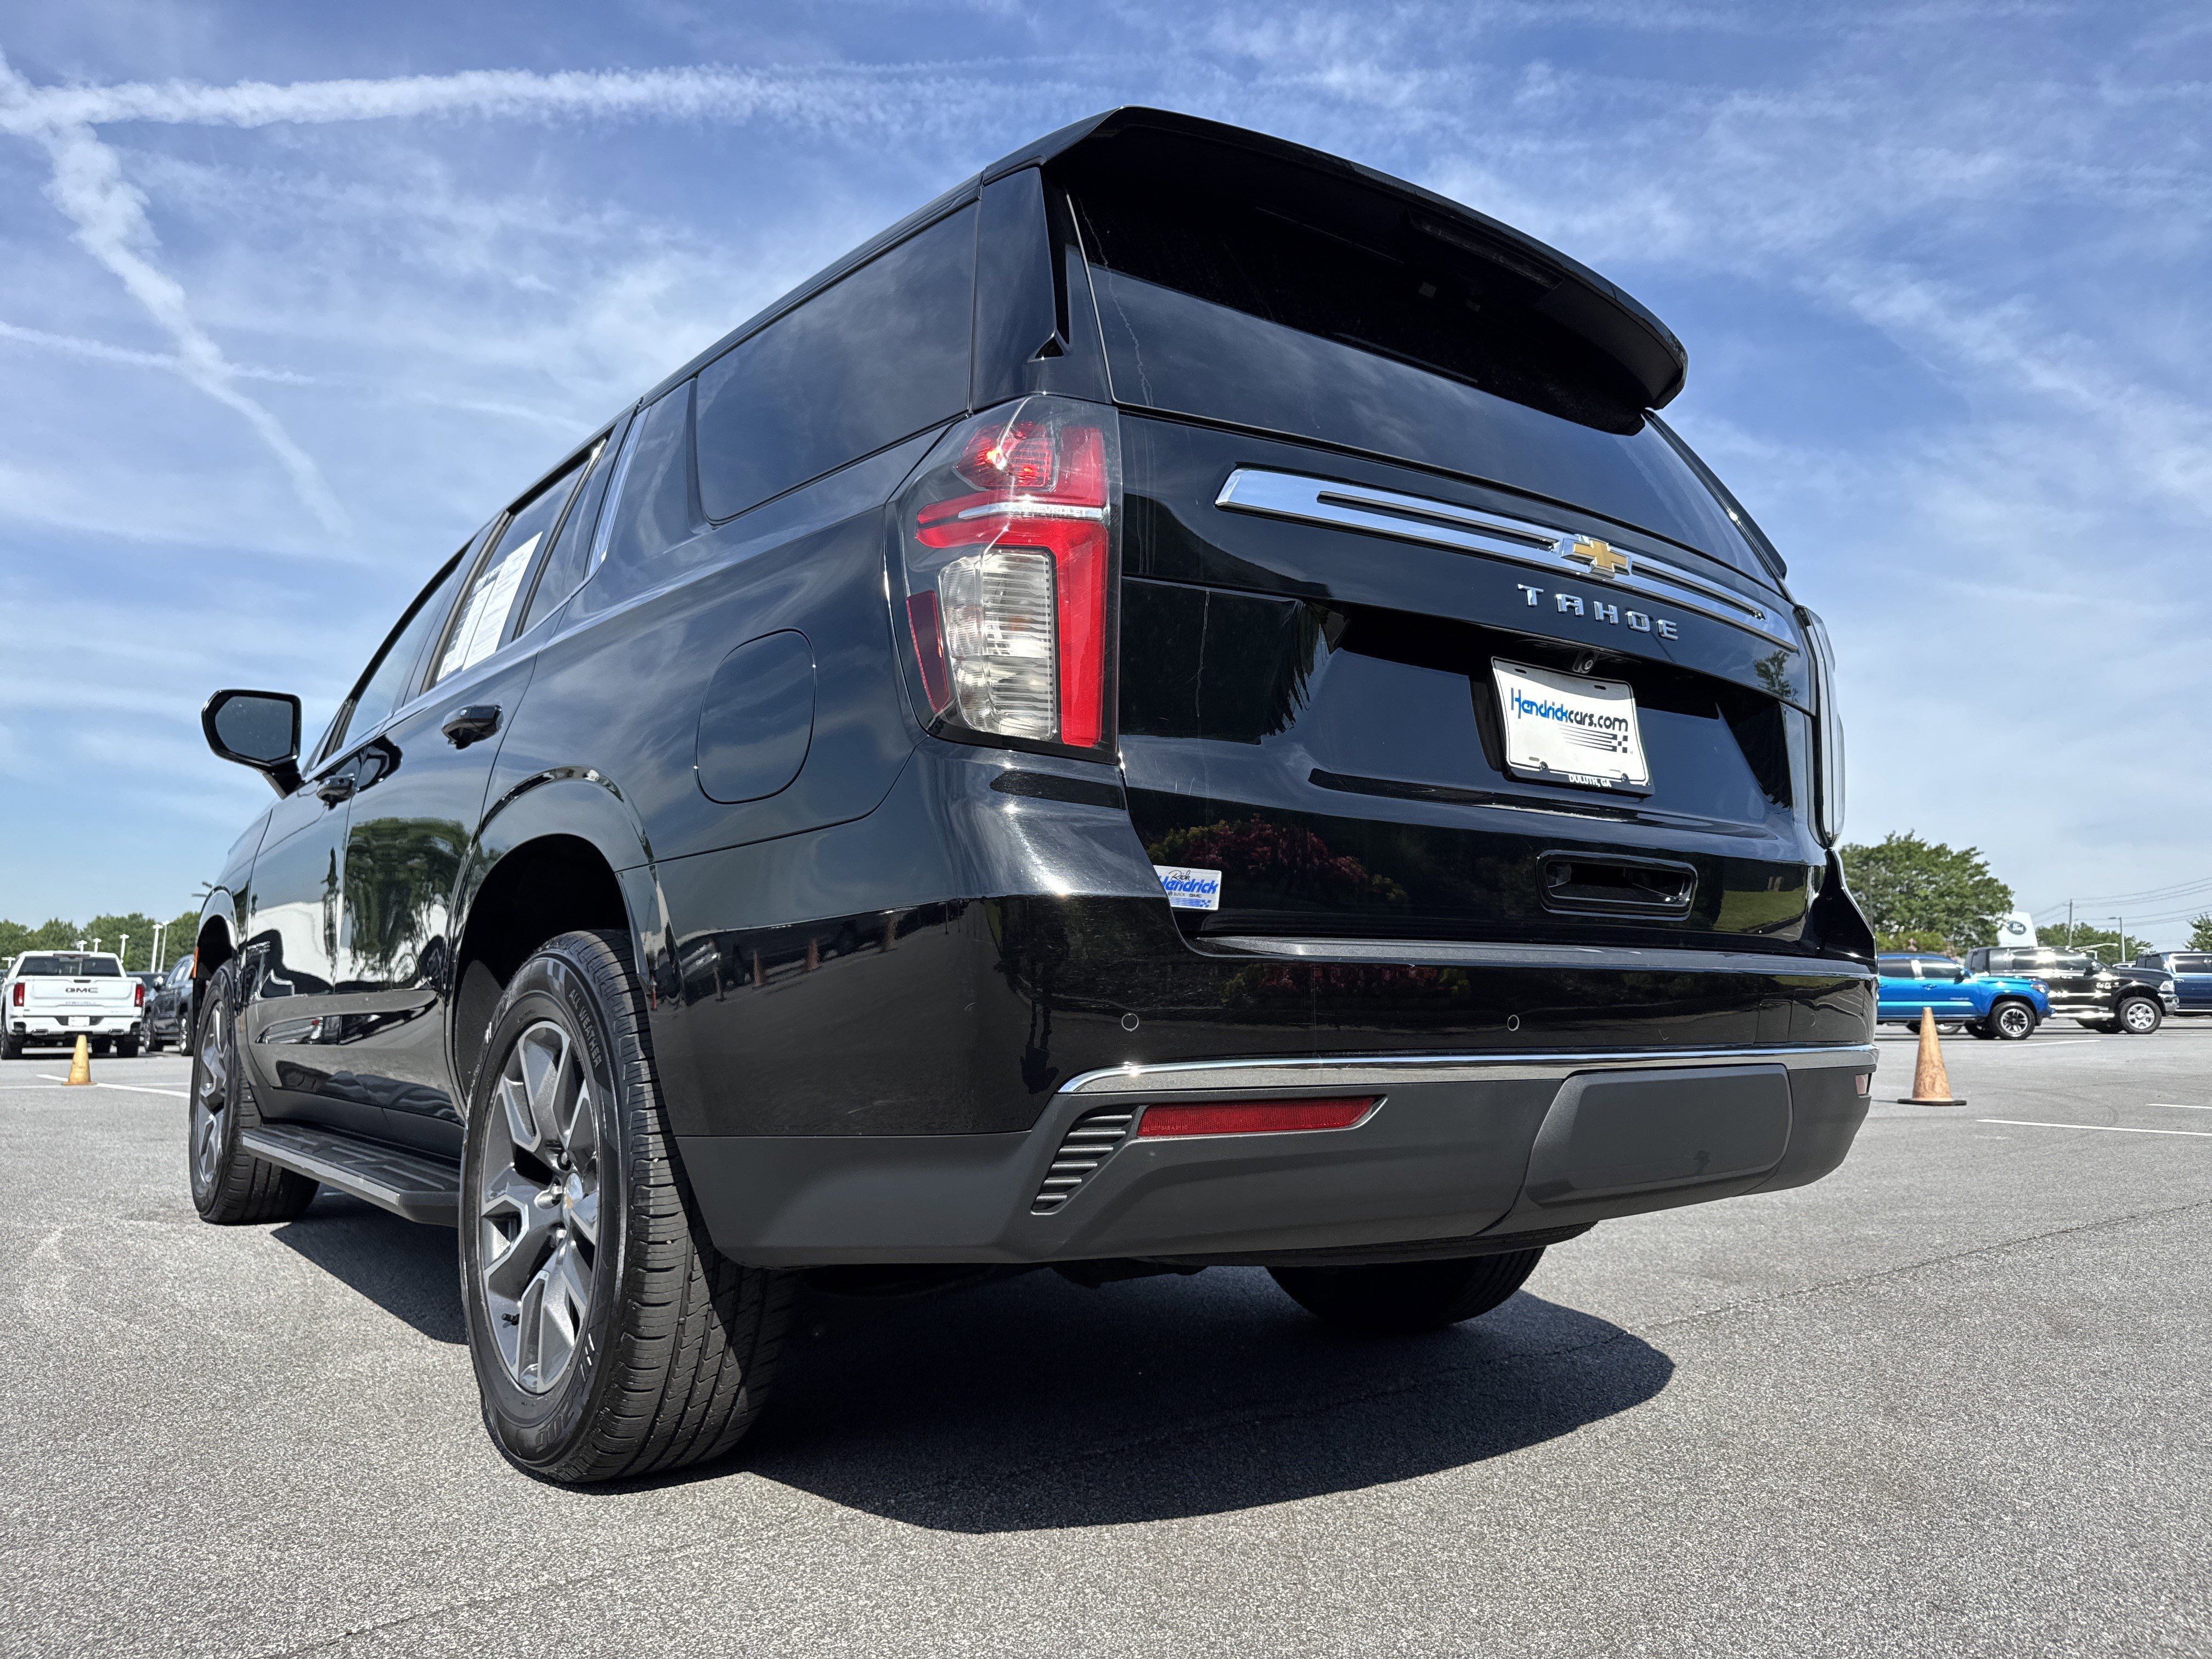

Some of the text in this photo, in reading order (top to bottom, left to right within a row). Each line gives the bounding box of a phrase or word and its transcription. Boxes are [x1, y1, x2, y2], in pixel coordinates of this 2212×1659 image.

[1022, 506, 1087, 517] CHEVROLET
[1517, 584, 1678, 640] TAHOE
[1511, 687, 1628, 732] Hendrickcars.com
[1568, 774, 1612, 787] DULUTH, GA
[568, 989, 581, 1010] ALL
[579, 1006, 602, 1068] WEATHER
